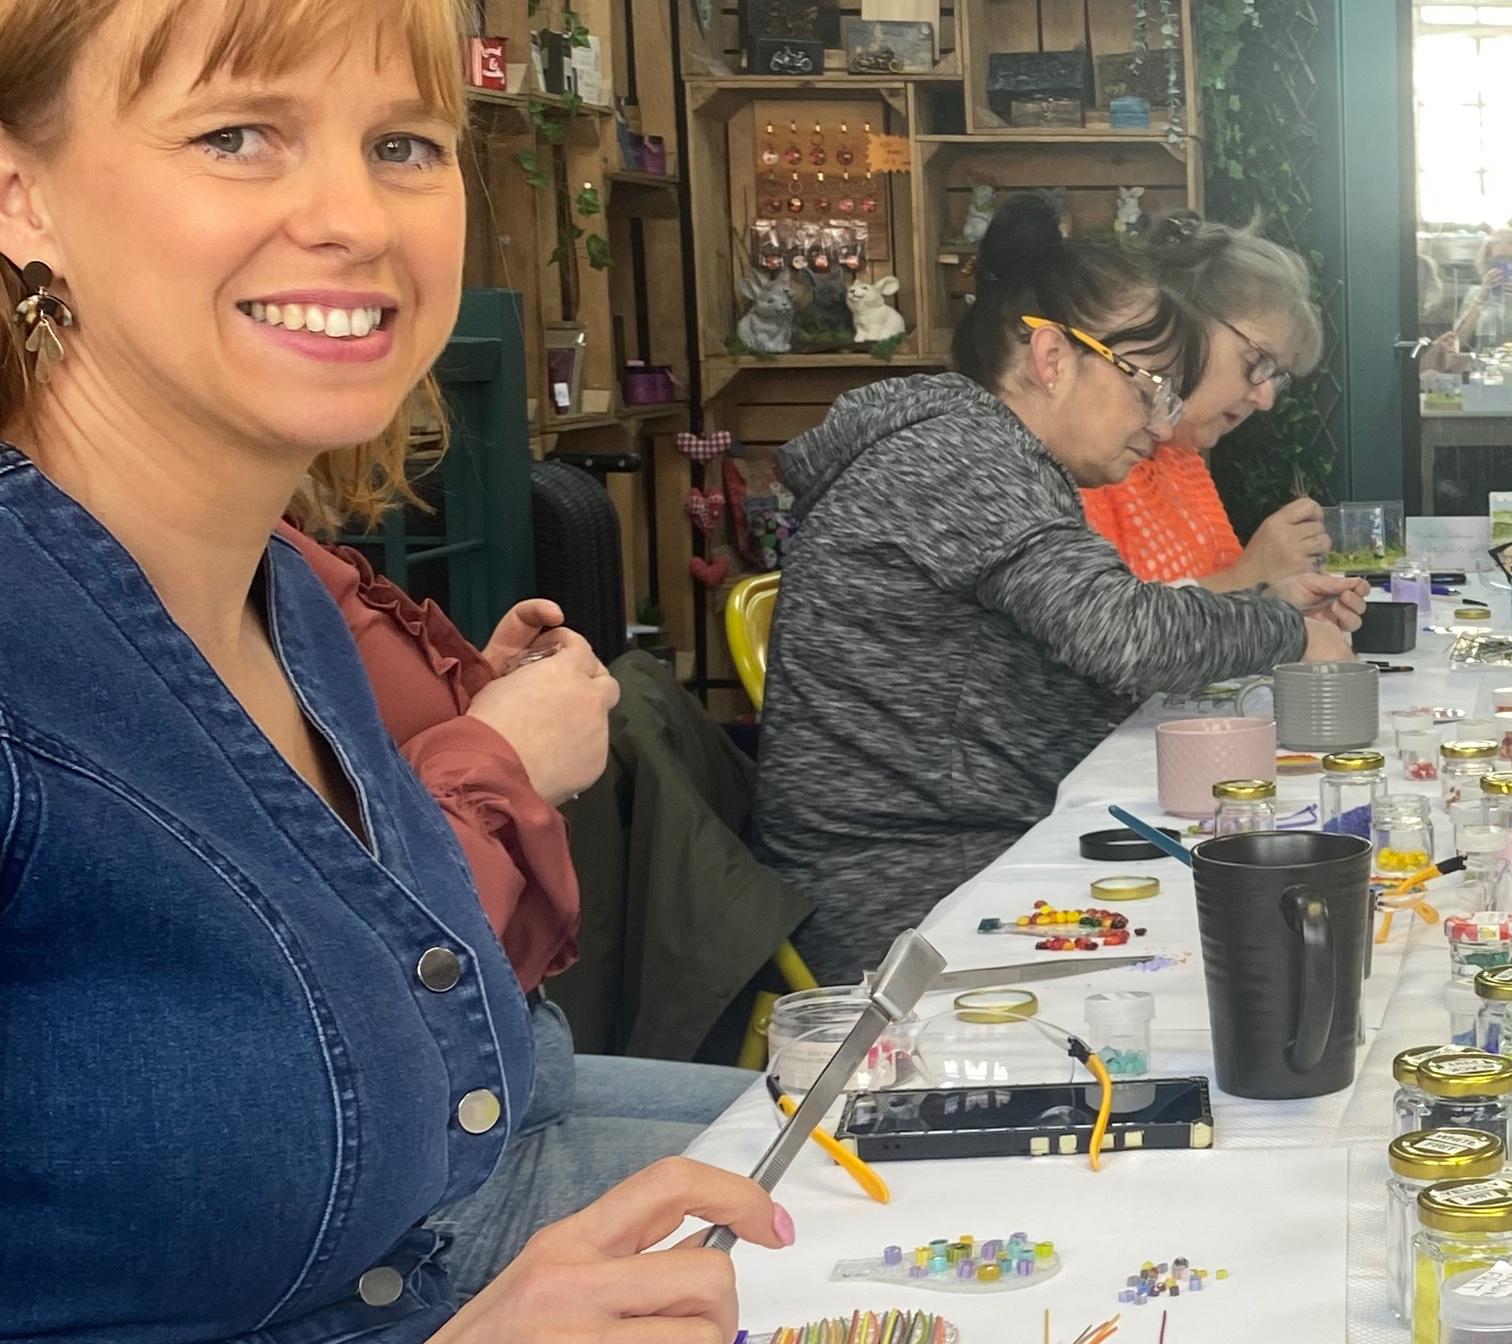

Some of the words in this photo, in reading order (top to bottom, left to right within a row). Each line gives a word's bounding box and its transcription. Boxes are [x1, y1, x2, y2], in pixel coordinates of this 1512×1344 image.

[1424, 1140, 1459, 1152] FRIT
[1436, 1134, 1477, 1147] WHITE
[1460, 1191, 1494, 1202] FRIT
